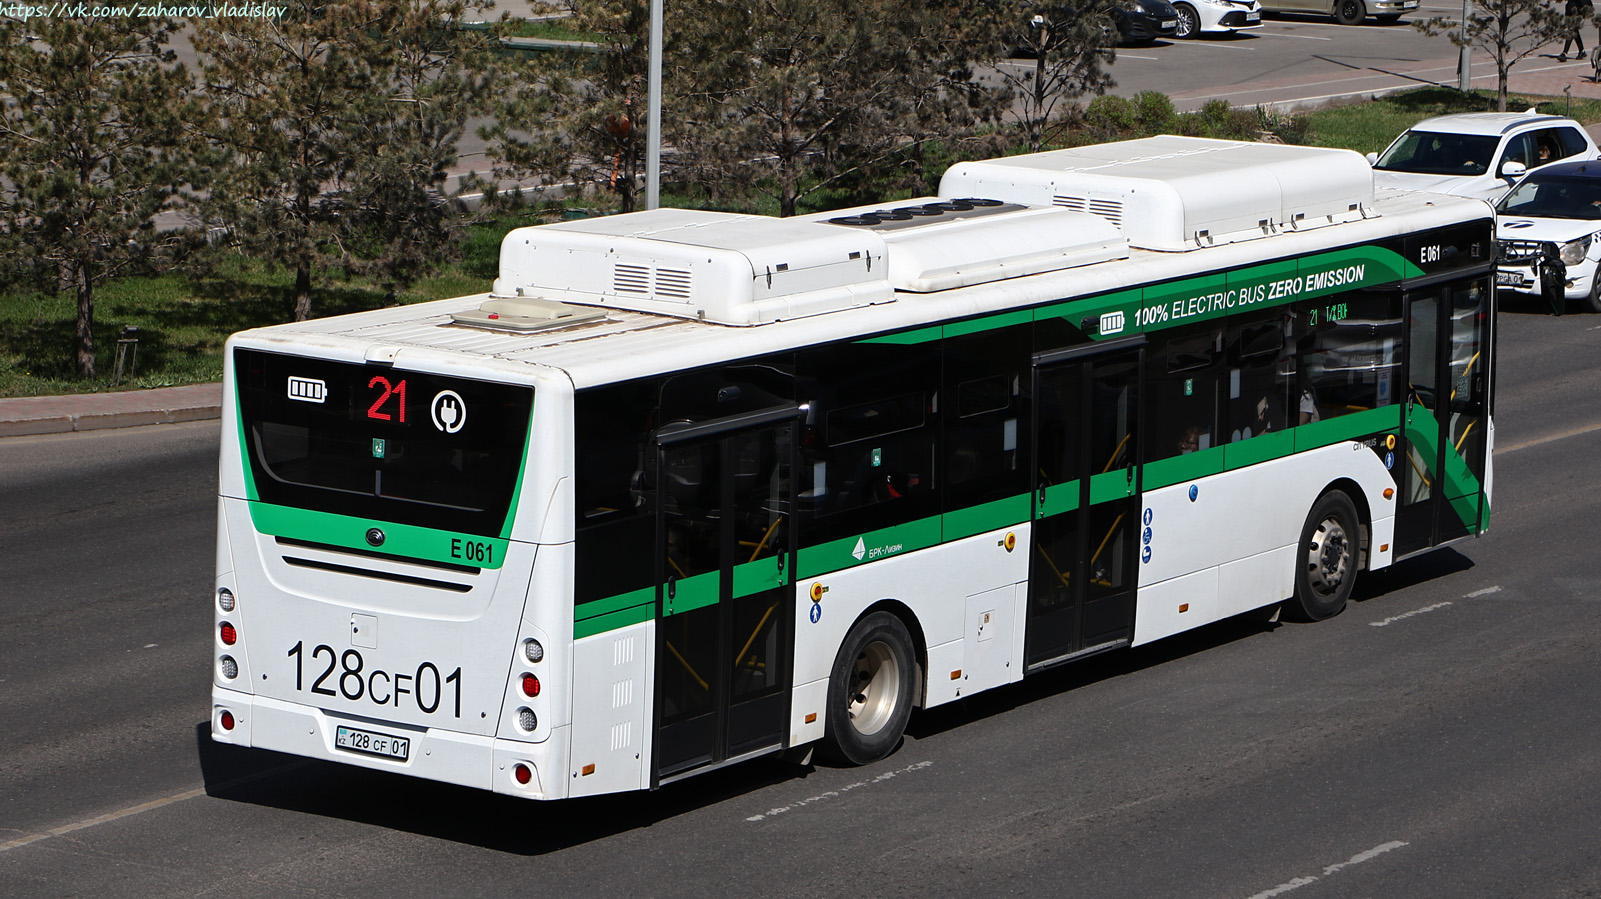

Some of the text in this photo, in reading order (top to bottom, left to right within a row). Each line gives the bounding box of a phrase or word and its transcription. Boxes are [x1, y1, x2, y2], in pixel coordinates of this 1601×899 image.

[1420, 244, 1440, 263] E 061
[1134, 264, 1365, 327] 100% ELECTRIC BUS ZERO EMISSION
[1310, 308, 1318, 326] 21
[367, 375, 406, 423] 21
[451, 538, 493, 564] E 061
[349, 732, 407, 756] 128 CF 01
